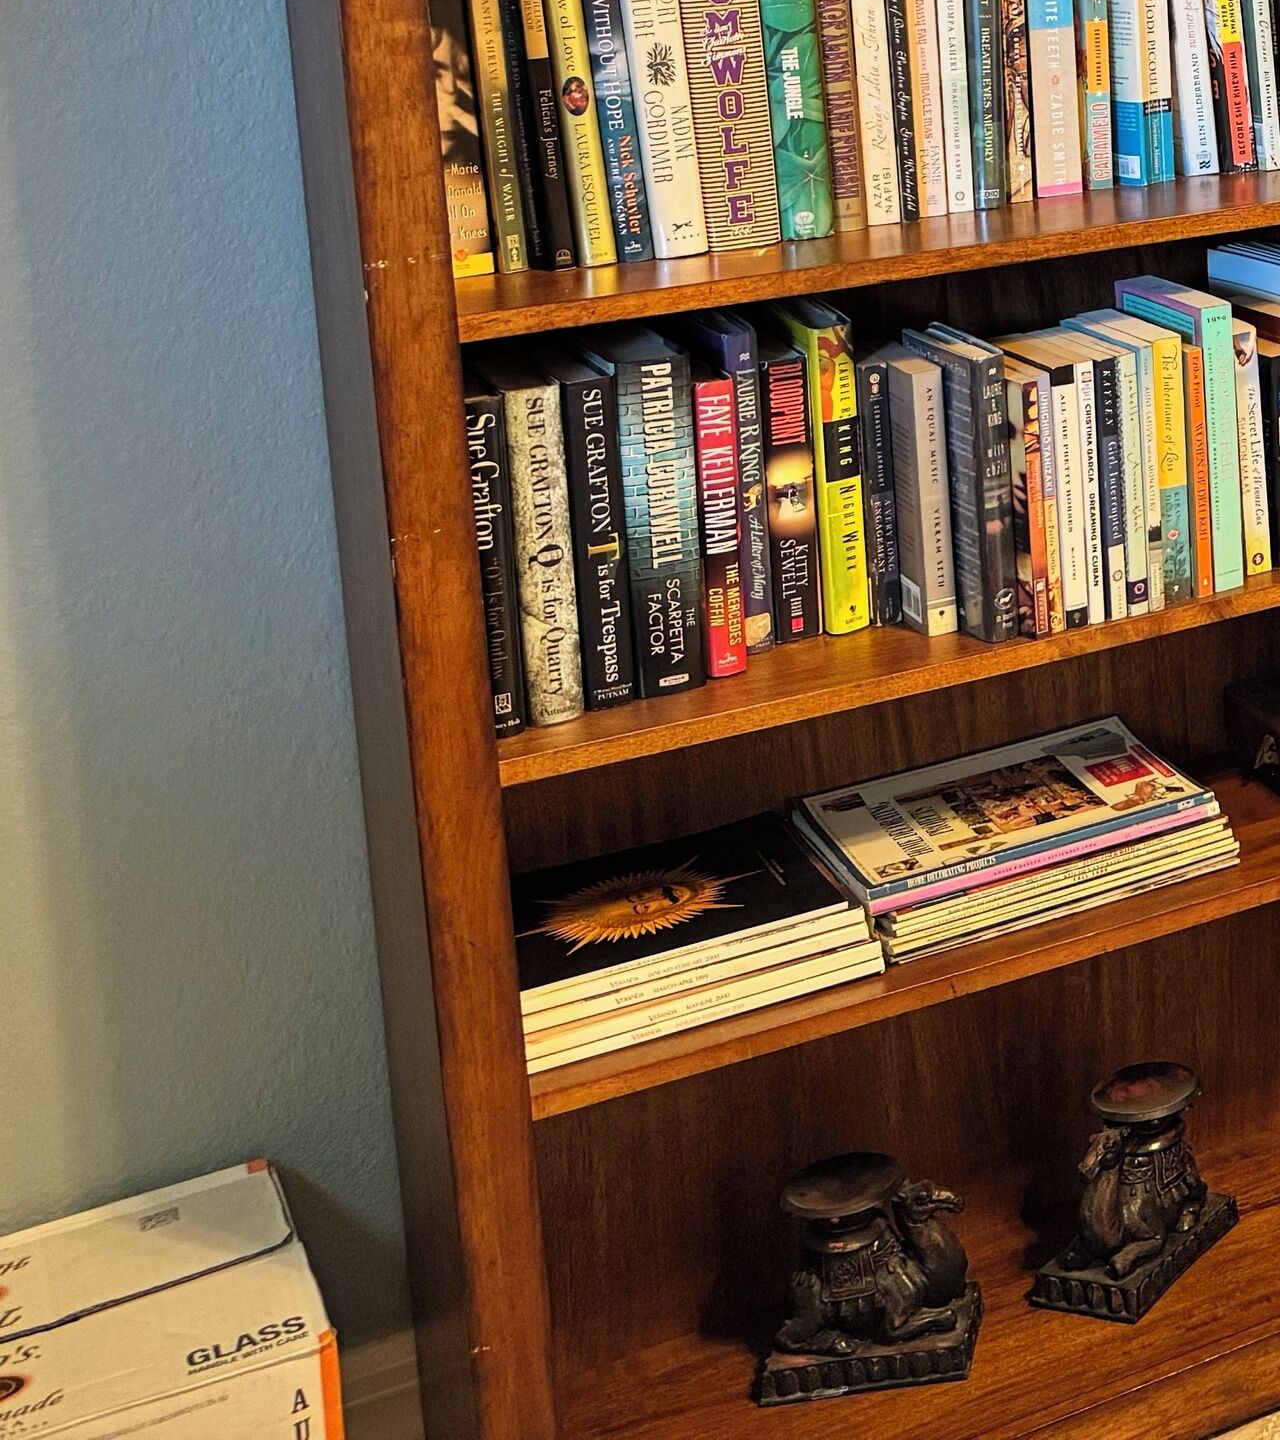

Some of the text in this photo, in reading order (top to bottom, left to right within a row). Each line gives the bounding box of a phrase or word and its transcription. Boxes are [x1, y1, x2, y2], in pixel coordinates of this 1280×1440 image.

[560, 16, 575, 30] of
[1047, 28, 1060, 70] TEETH
[562, 35, 576, 72] Love
[601, 80, 625, 132] HOPE
[780, 47, 804, 121] THE JUNGLE
[669, 105, 695, 162] NADINE
[707, 48, 756, 226] WOLFE
[1050, 92, 1065, 136] ZADIE
[1091, 102, 1110, 181] CARAMELO
[574, 122, 591, 171] LAURA
[1050, 141, 1067, 186] SMITH
[582, 173, 602, 245] ESQUIVEL
[618, 135, 642, 235] Nick Schuyler
[872, 174, 882, 209] AZAR
[882, 167, 892, 213] NAFISI
[768, 362, 807, 446] BLOODPRINT
[1102, 370, 1113, 426] KAYSEN
[465, 413, 503, 550] Sue Grafton
[640, 362, 684, 569] PATRICIA CORNWELL
[698, 394, 738, 556] FAYE KELLERMAN
[525, 396, 567, 696] SUE GRAFTON Q is for Quarry
[582, 388, 621, 683] SUE GRAFTON T is for Trespass
[874, 501, 886, 574] ENGAGEMENT
[780, 539, 797, 599] SEWELL
[795, 543, 810, 587] KITTY
[647, 593, 665, 656] FACTOR
[666, 578, 685, 664] SCARPETTA
[685, 607, 696, 627] THE
[708, 588, 725, 627] COFFIN
[725, 563, 742, 646] THE MERCEDES
[186, 1316, 305, 1366] GLASS
[277, 1331, 309, 1346] CARE
